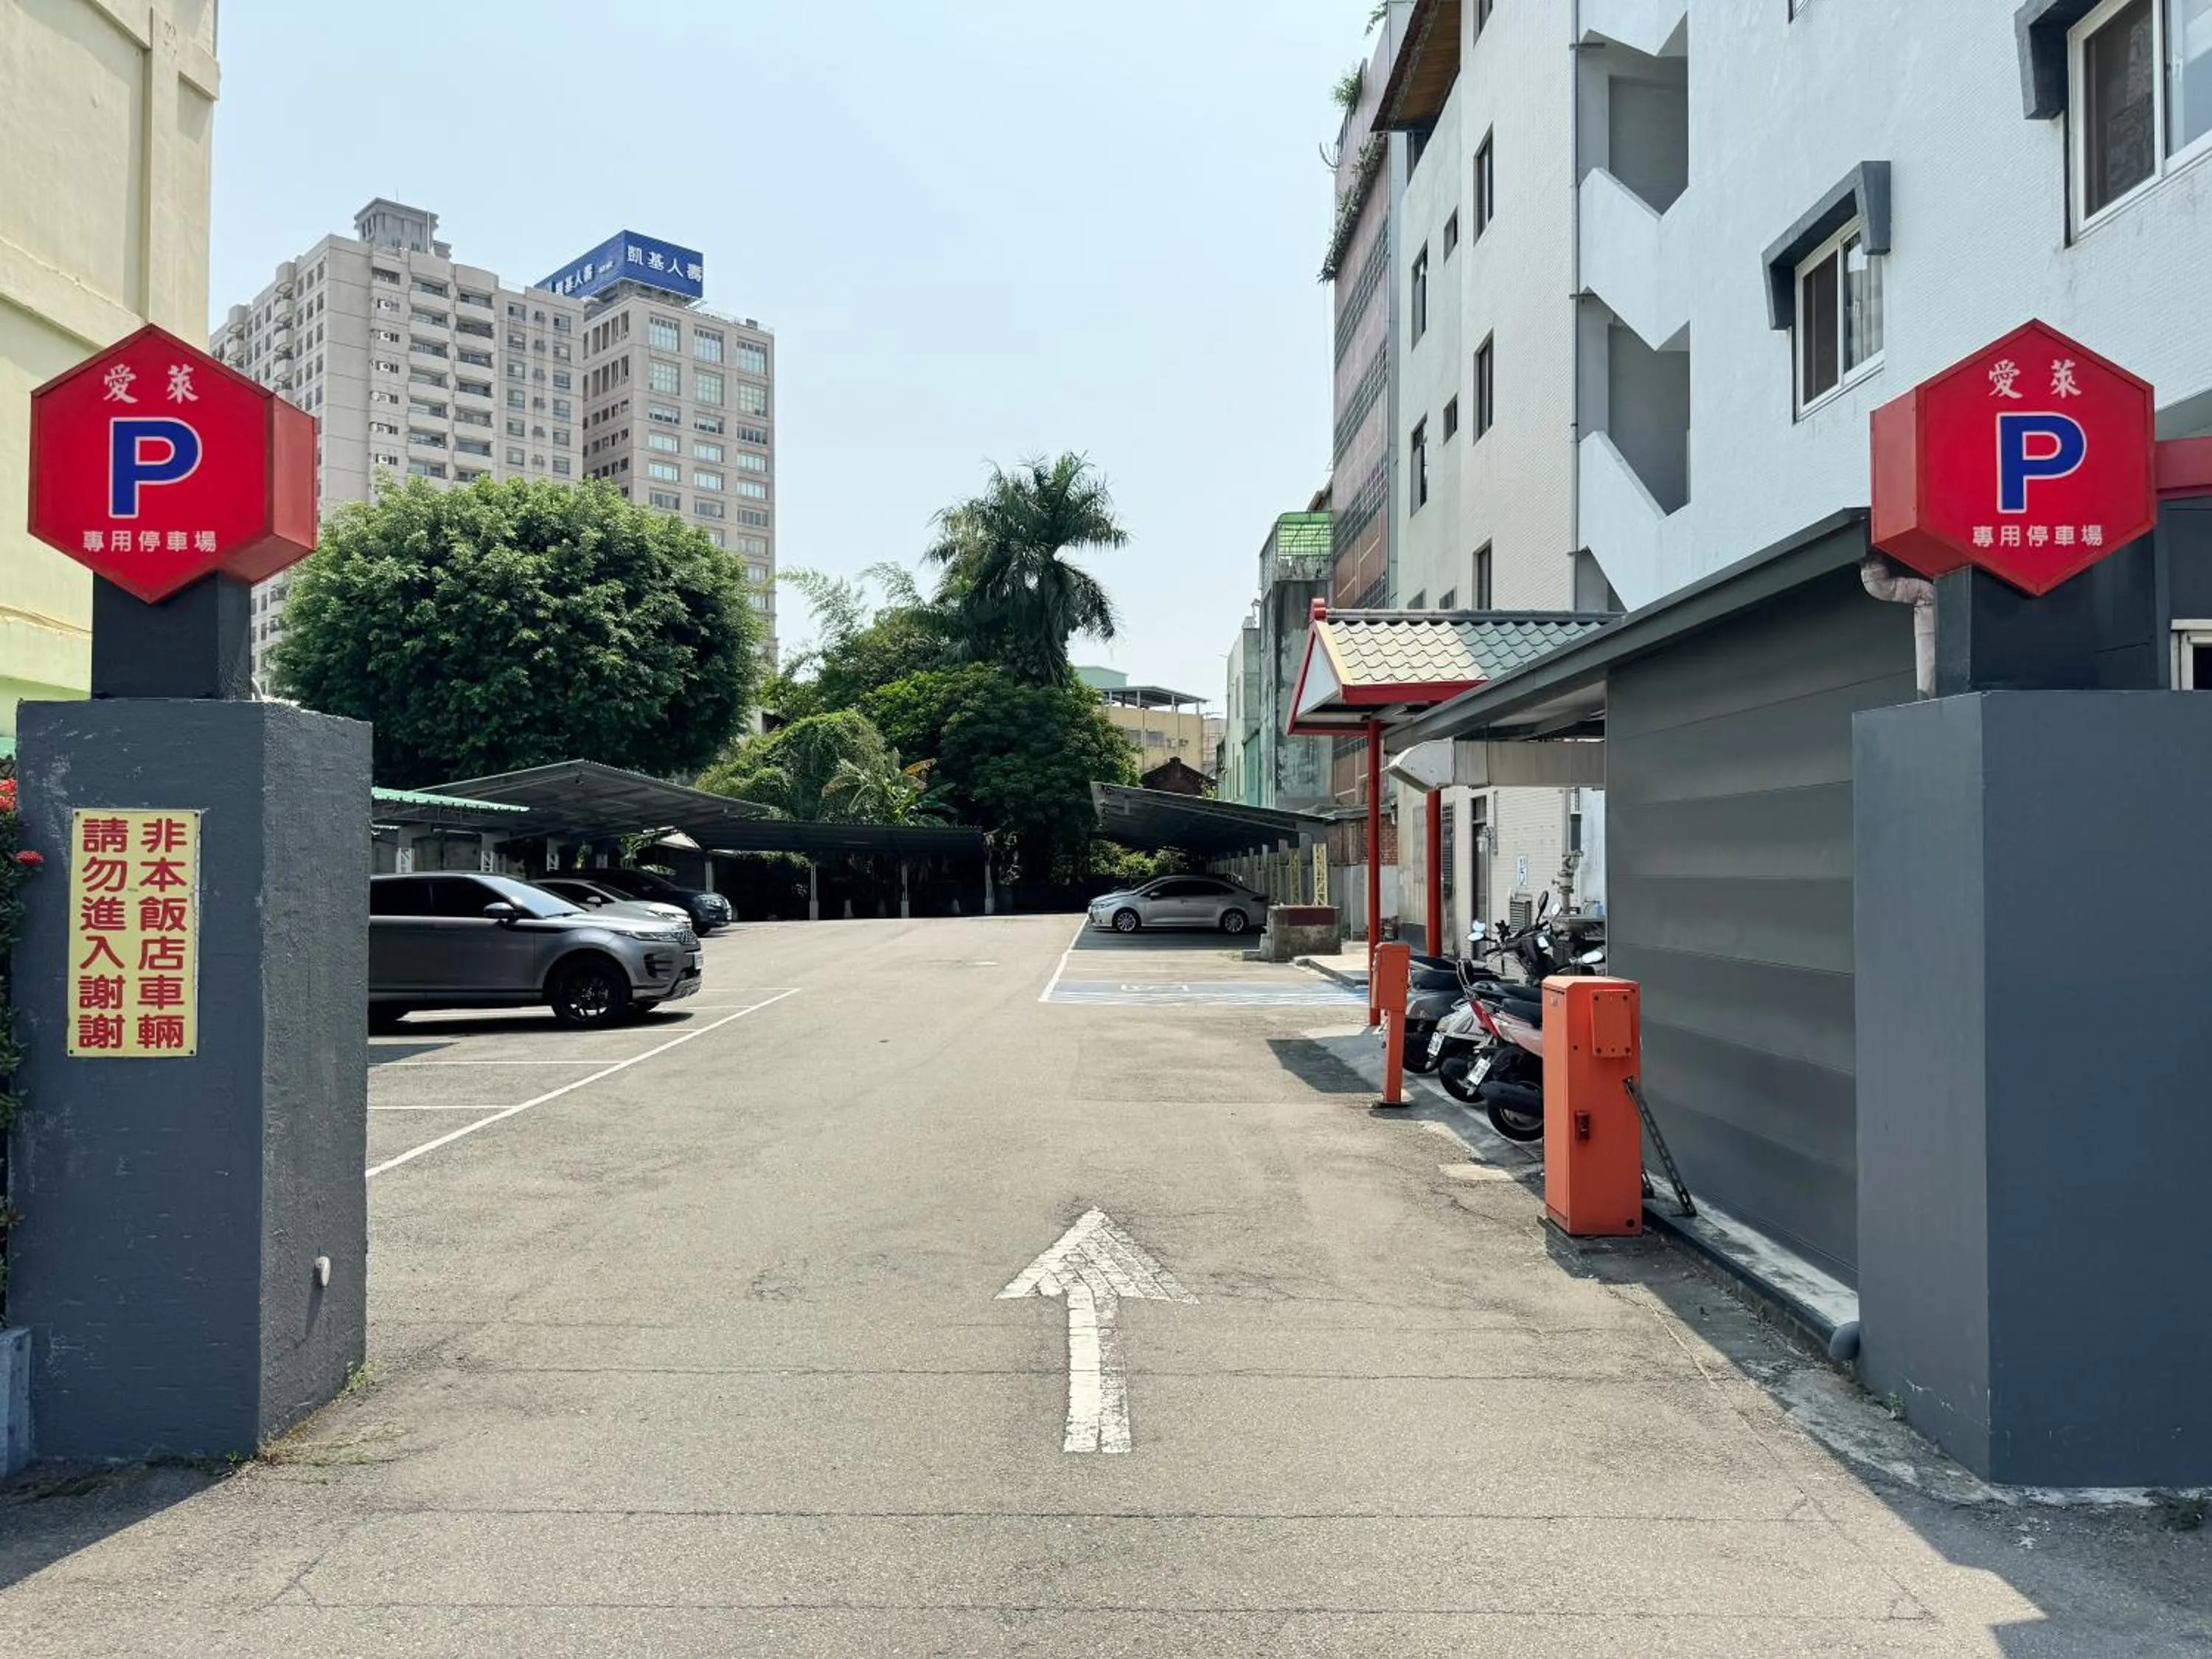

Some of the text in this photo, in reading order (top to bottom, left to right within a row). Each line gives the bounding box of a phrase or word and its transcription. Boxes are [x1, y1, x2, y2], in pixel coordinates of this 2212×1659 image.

[627, 245, 702, 282] 凱基人壽
[103, 364, 199, 404] 愛萊
[1988, 359, 2081, 399] 愛萊
[108, 417, 203, 518] P
[1996, 411, 2087, 513] P
[83, 530, 217, 553] 專用停車場
[1972, 525, 2103, 547] 專用停車場
[77, 817, 129, 1050] 請勿進入謝謝
[136, 818, 188, 1049] 非本飯店車輛
